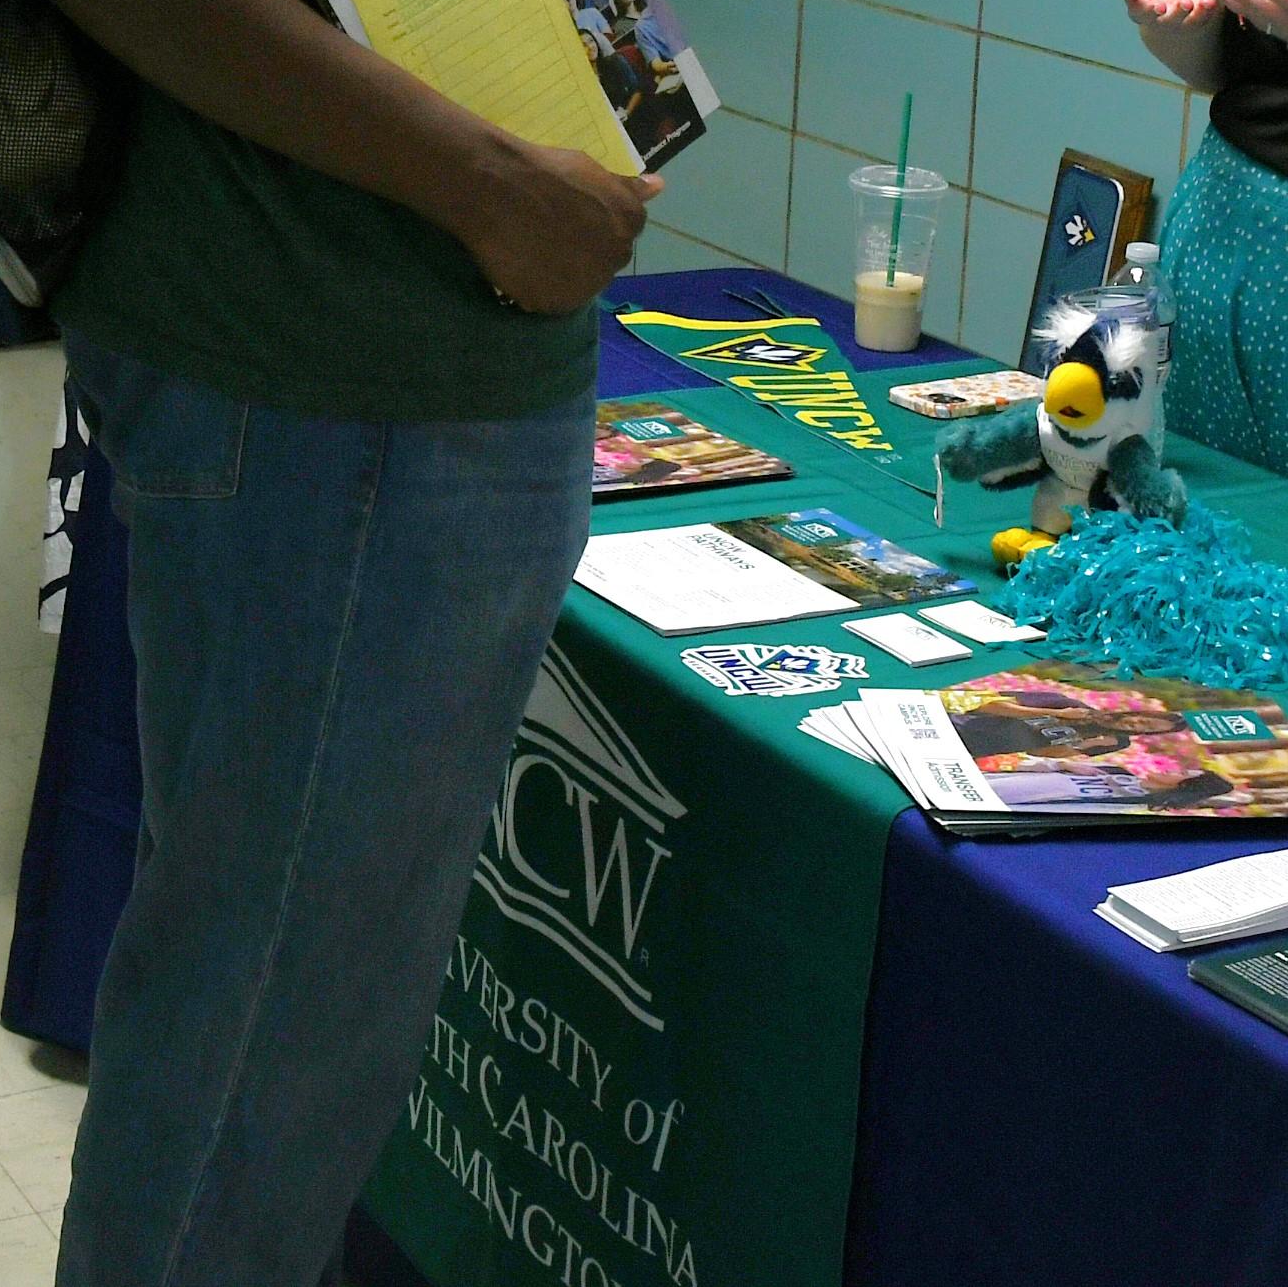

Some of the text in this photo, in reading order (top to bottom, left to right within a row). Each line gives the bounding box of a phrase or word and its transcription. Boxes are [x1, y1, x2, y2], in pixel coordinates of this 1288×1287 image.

[727, 371, 894, 450] UNCW
[687, 535, 755, 570] PATHWAYS
[702, 533, 748, 554] UNCW
[694, 649, 785, 691] UNCW
[925, 762, 952, 792] Admission
[943, 762, 984, 802] TRANSFER
[447, 934, 685, 1173] VERSITY of
[480, 1055, 698, 1287] CAROLINA
